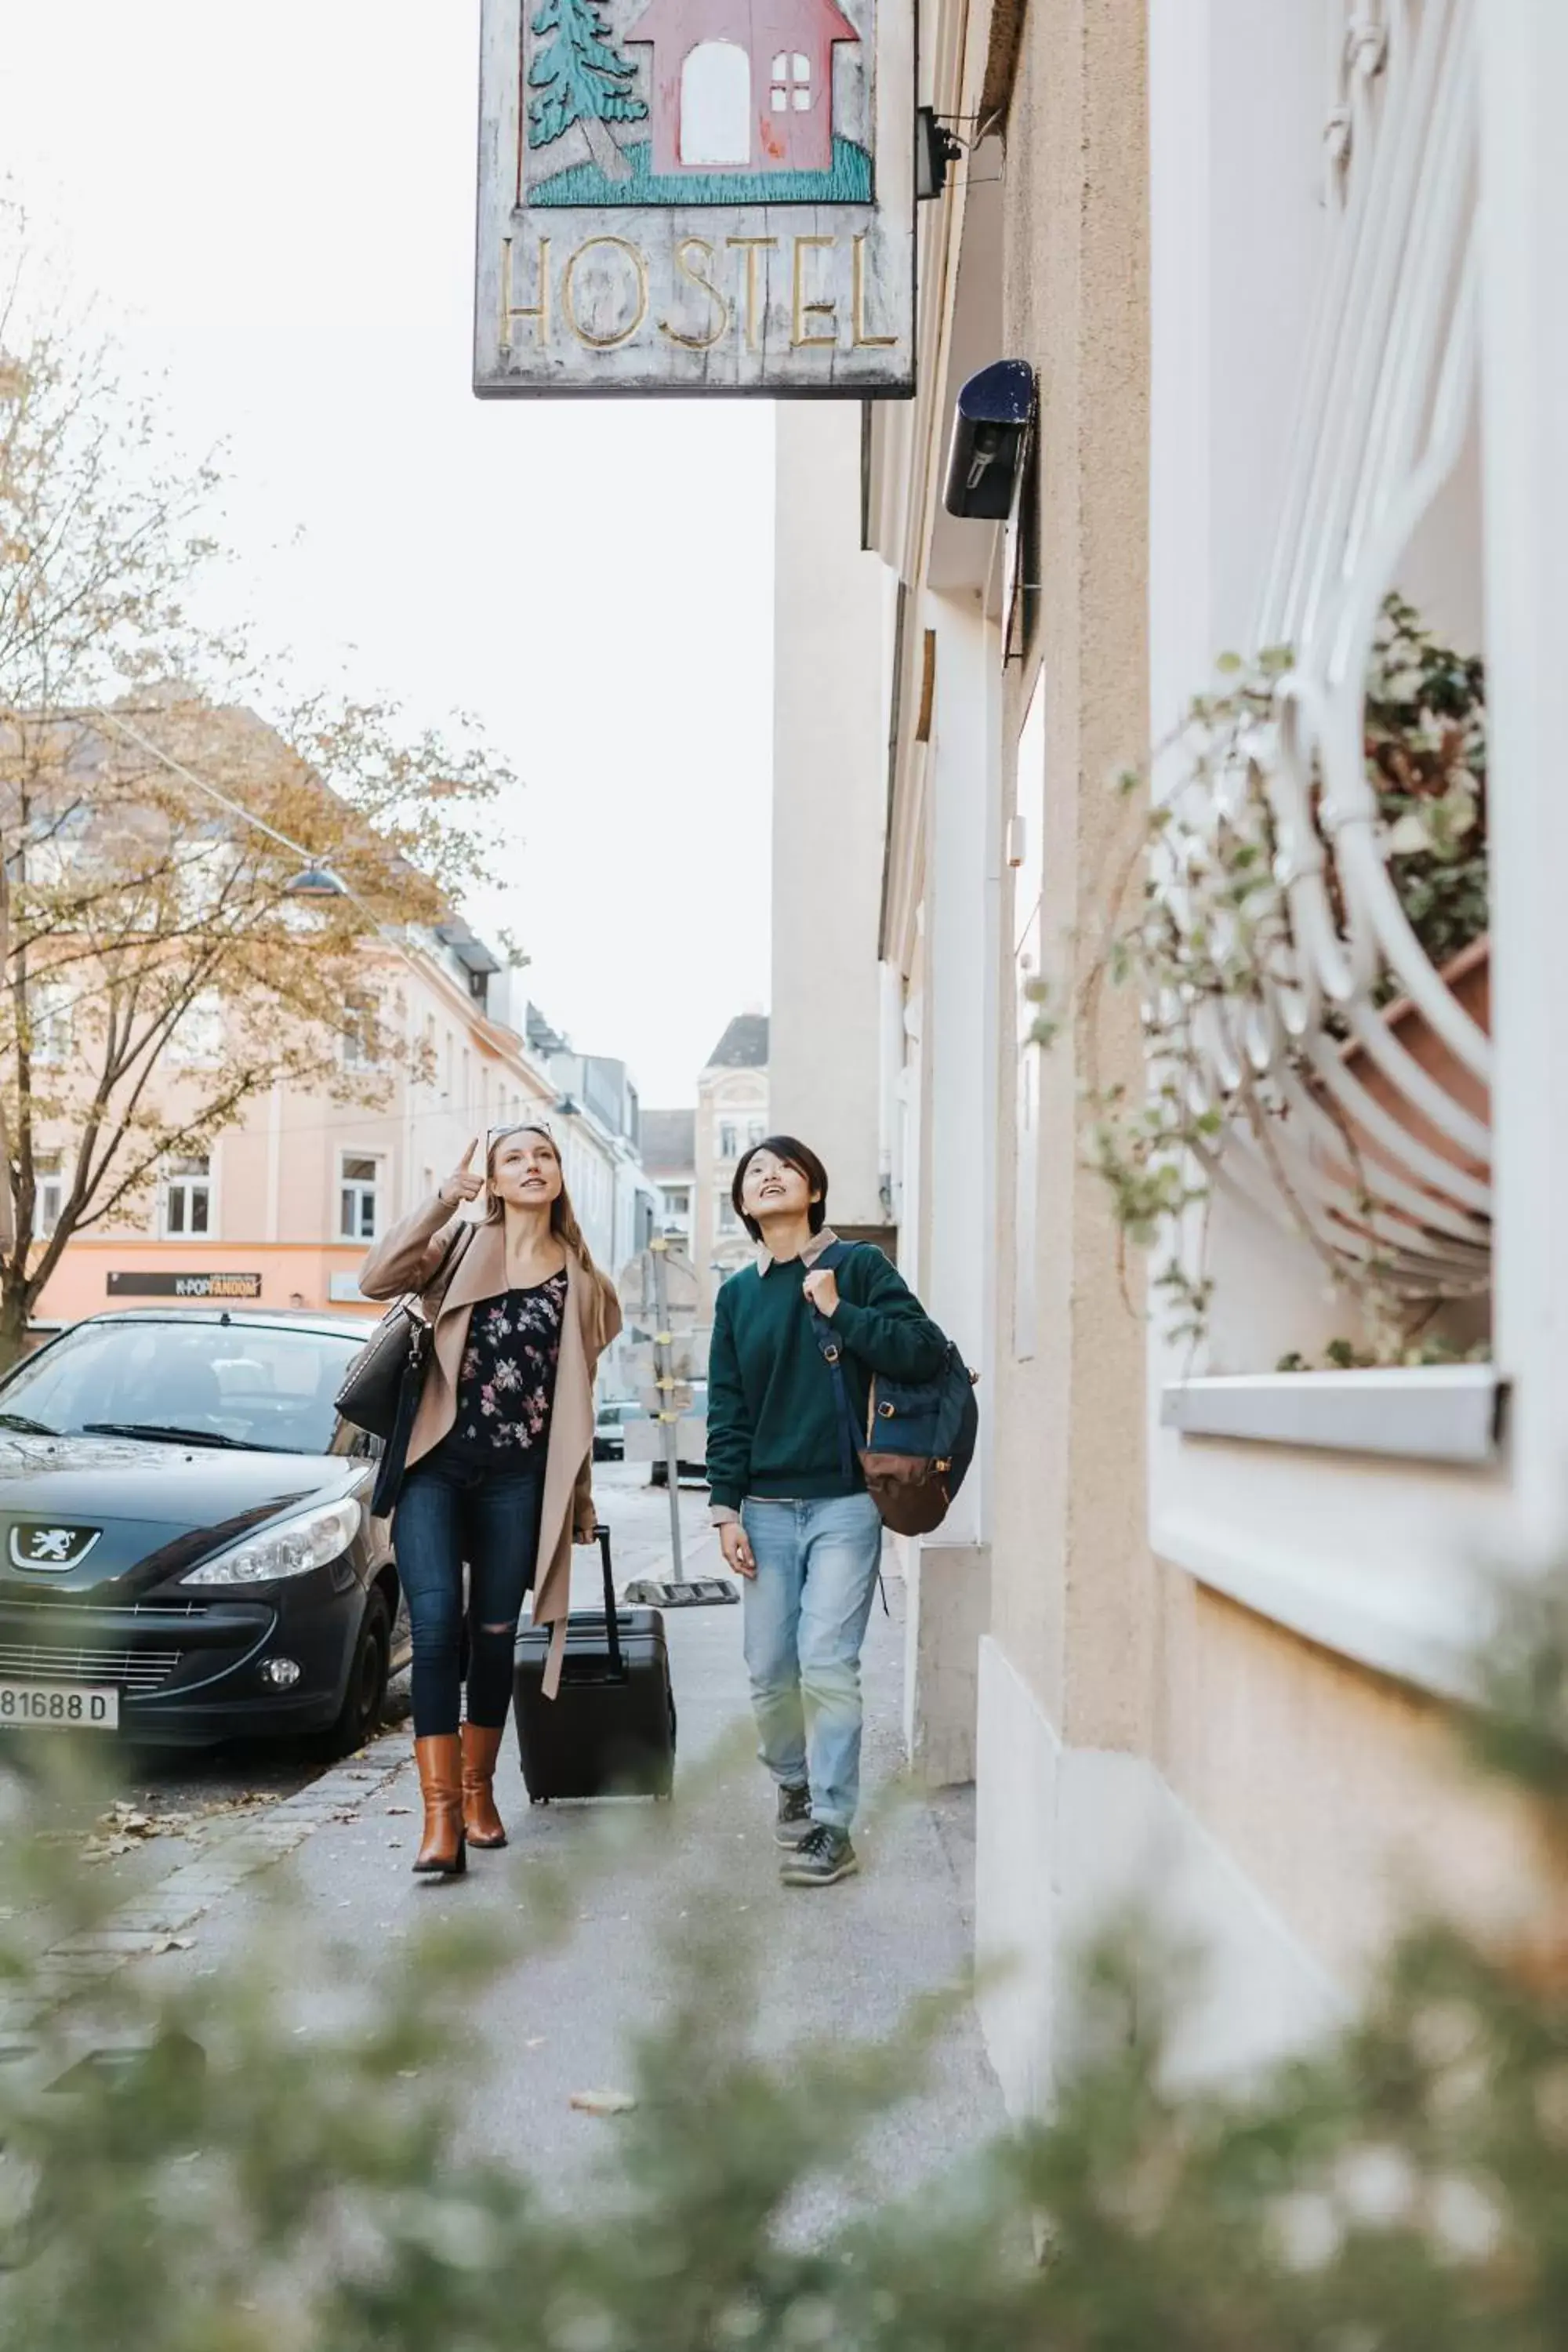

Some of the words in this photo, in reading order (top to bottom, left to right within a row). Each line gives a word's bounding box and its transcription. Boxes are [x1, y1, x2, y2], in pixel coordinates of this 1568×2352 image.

[500, 236, 900, 350] HOSTEL
[1, 1690, 82, 1719] 81688
[90, 1695, 106, 1720] D
